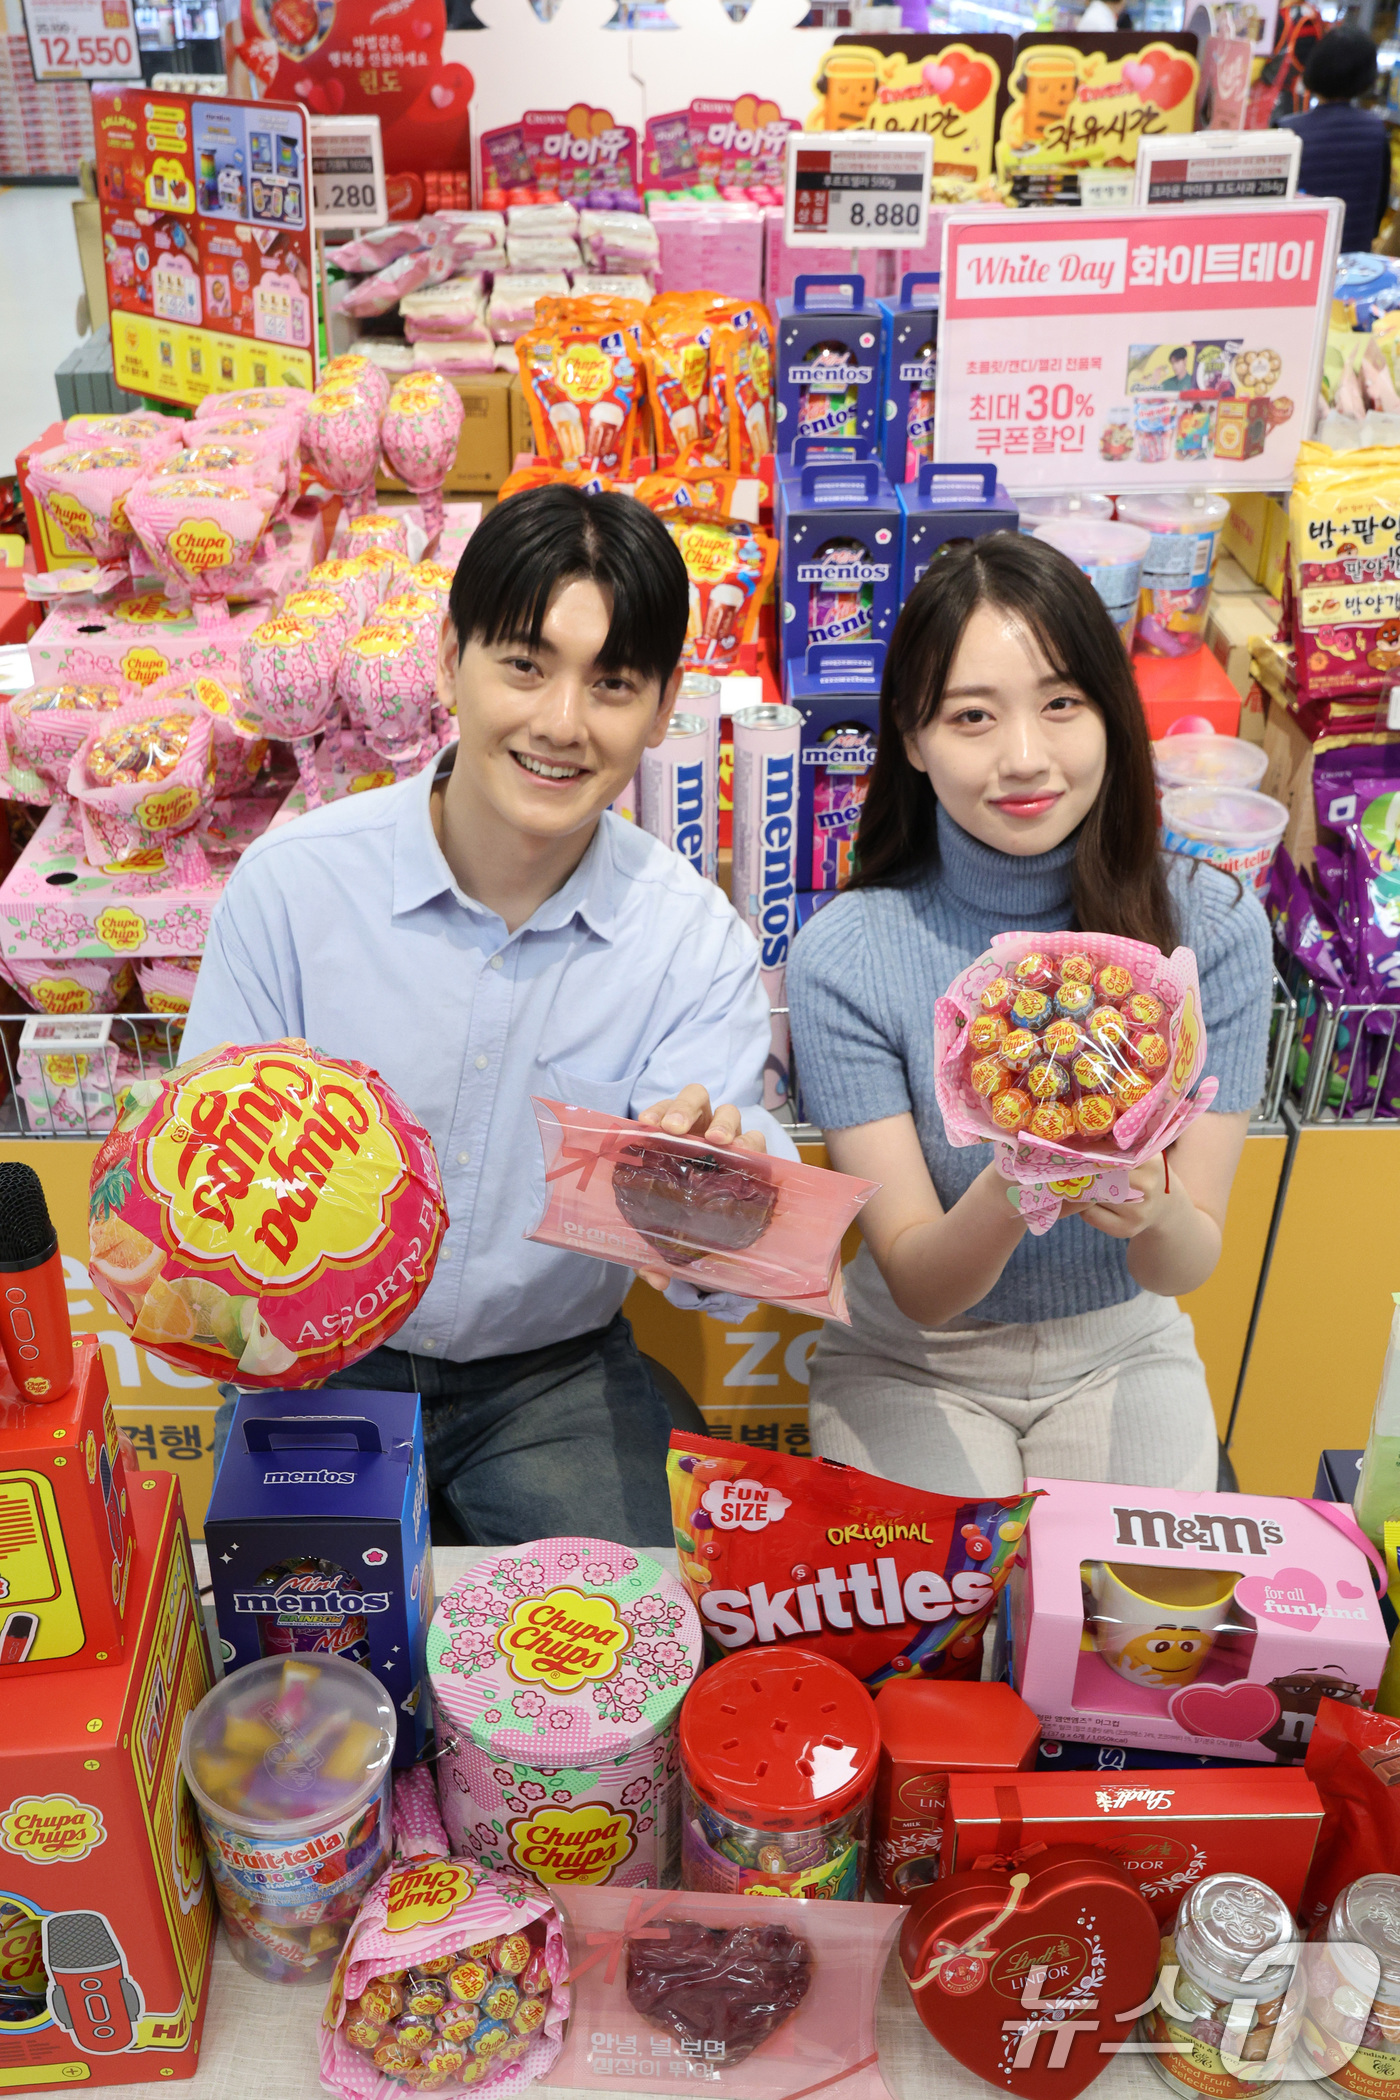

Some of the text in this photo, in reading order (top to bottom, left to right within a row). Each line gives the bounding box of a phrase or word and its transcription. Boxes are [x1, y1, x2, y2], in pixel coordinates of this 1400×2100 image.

[40, 37, 132, 68] 12,550
[359, 69, 402, 95] 린도
[707, 121, 789, 157] 마이쮸
[1047, 105, 1168, 153] 자유시간
[543, 128, 631, 166] 마이쮸
[967, 253, 1116, 288] White Day
[1128, 239, 1315, 287] 화이트데이
[790, 366, 872, 383] mentos
[1066, 356, 1103, 372] 전품목
[969, 384, 1095, 421] 최대 30%
[799, 404, 857, 437] entos
[975, 425, 1086, 456] 쿠폰할인
[176, 532, 227, 550] Chupa
[687, 535, 731, 551] Chupa
[175, 547, 225, 566] Chups
[798, 561, 889, 581] mentos
[127, 658, 164, 672] Chupa
[145, 791, 193, 816] Chupa
[760, 753, 795, 968] mentos
[102, 917, 140, 931] Chupa
[102, 927, 141, 945] Chups
[36, 987, 86, 1001] Chupa
[177, 1059, 311, 1234] Chups
[254, 1083, 370, 1266] Chupa
[263, 1469, 355, 1485] mentos
[723, 1485, 770, 1502] FUN
[720, 1502, 768, 1523] SIZE
[275, 1574, 344, 1597] Mini
[1264, 1585, 1305, 1601] for all
[233, 1590, 391, 1614] mentos
[699, 1557, 995, 1648] Skittles
[1264, 1600, 1370, 1621] funkind
[528, 1605, 620, 1647] Chupa
[510, 1628, 604, 1675] Chups
[1095, 1718, 1120, 1728] 머그컵
[1110, 1787, 1176, 1811] Lindt
[14, 1811, 86, 1830] Chupa
[14, 1827, 88, 1853] Chups
[527, 1822, 619, 1850] Chupa
[217, 1831, 344, 1871] Fruit-tella
[523, 1843, 617, 1881] Chups
[389, 1866, 460, 1898] Chup
[1006, 1945, 1056, 1973] Lindt
[1011, 1965, 1070, 1990] LINDOR
[590, 2032, 726, 2060] 안녕, 널 보면
[668, 2061, 715, 2080] 뛰어
[1168, 2053, 1232, 2088] Mixed Fruit
[1170, 2063, 1224, 2095] Selection
[1345, 2069, 1383, 2088] Mixed
